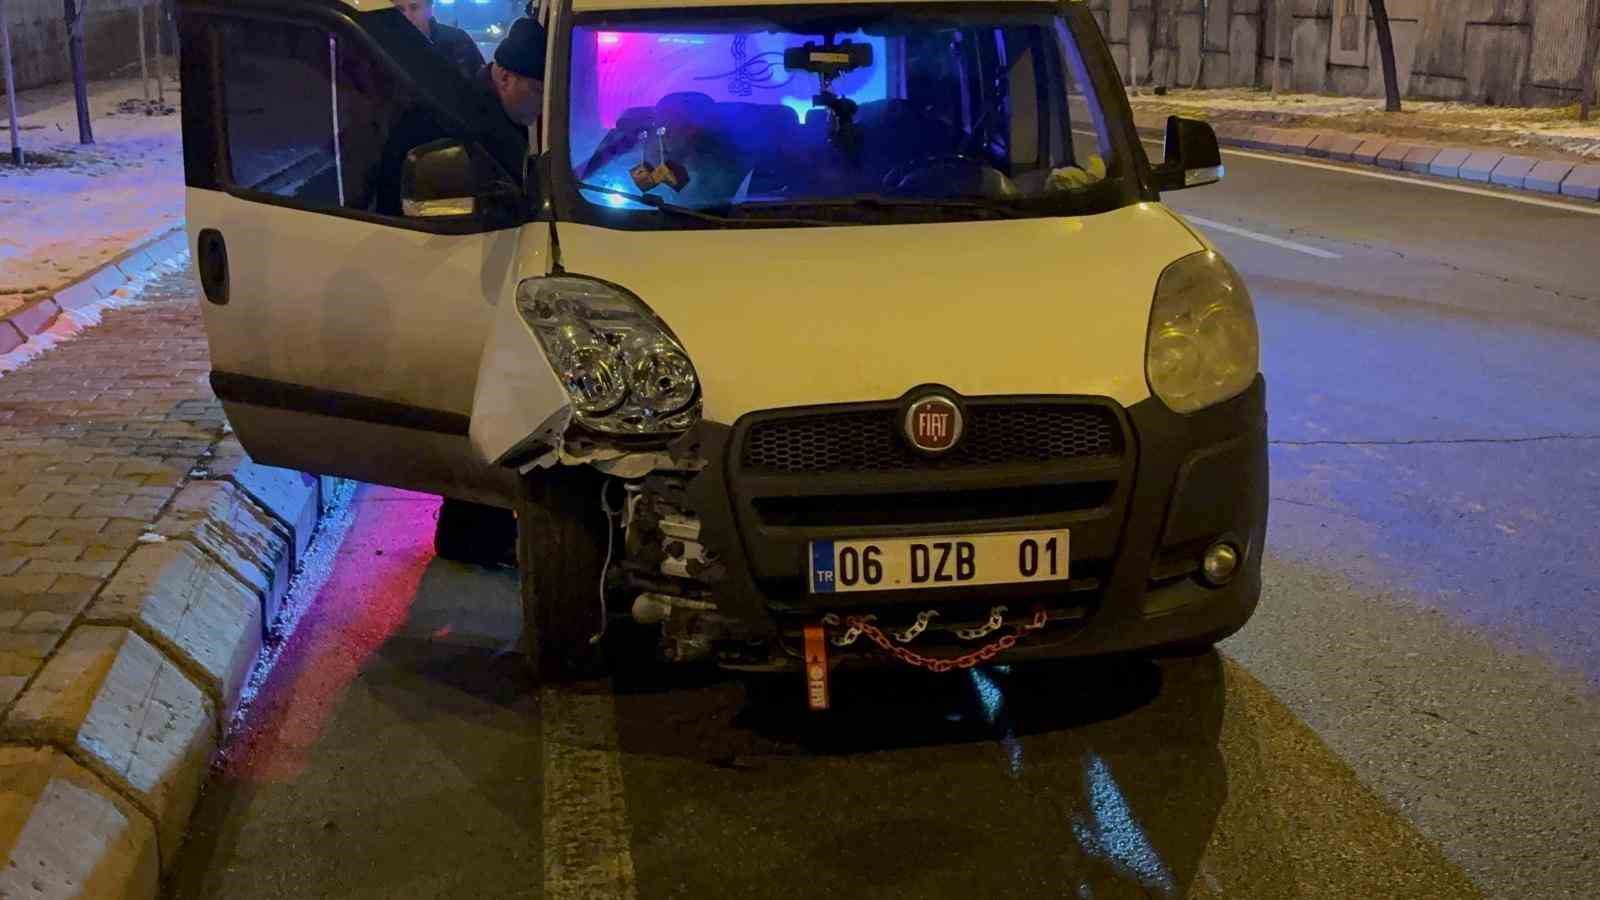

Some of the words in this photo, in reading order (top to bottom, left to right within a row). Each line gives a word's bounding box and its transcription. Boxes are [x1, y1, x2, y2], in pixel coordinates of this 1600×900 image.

[919, 413, 949, 437] FIAT
[839, 545, 882, 586] 06
[910, 542, 976, 583] DZB
[1019, 537, 1057, 577] 01
[816, 570, 833, 582] TR
